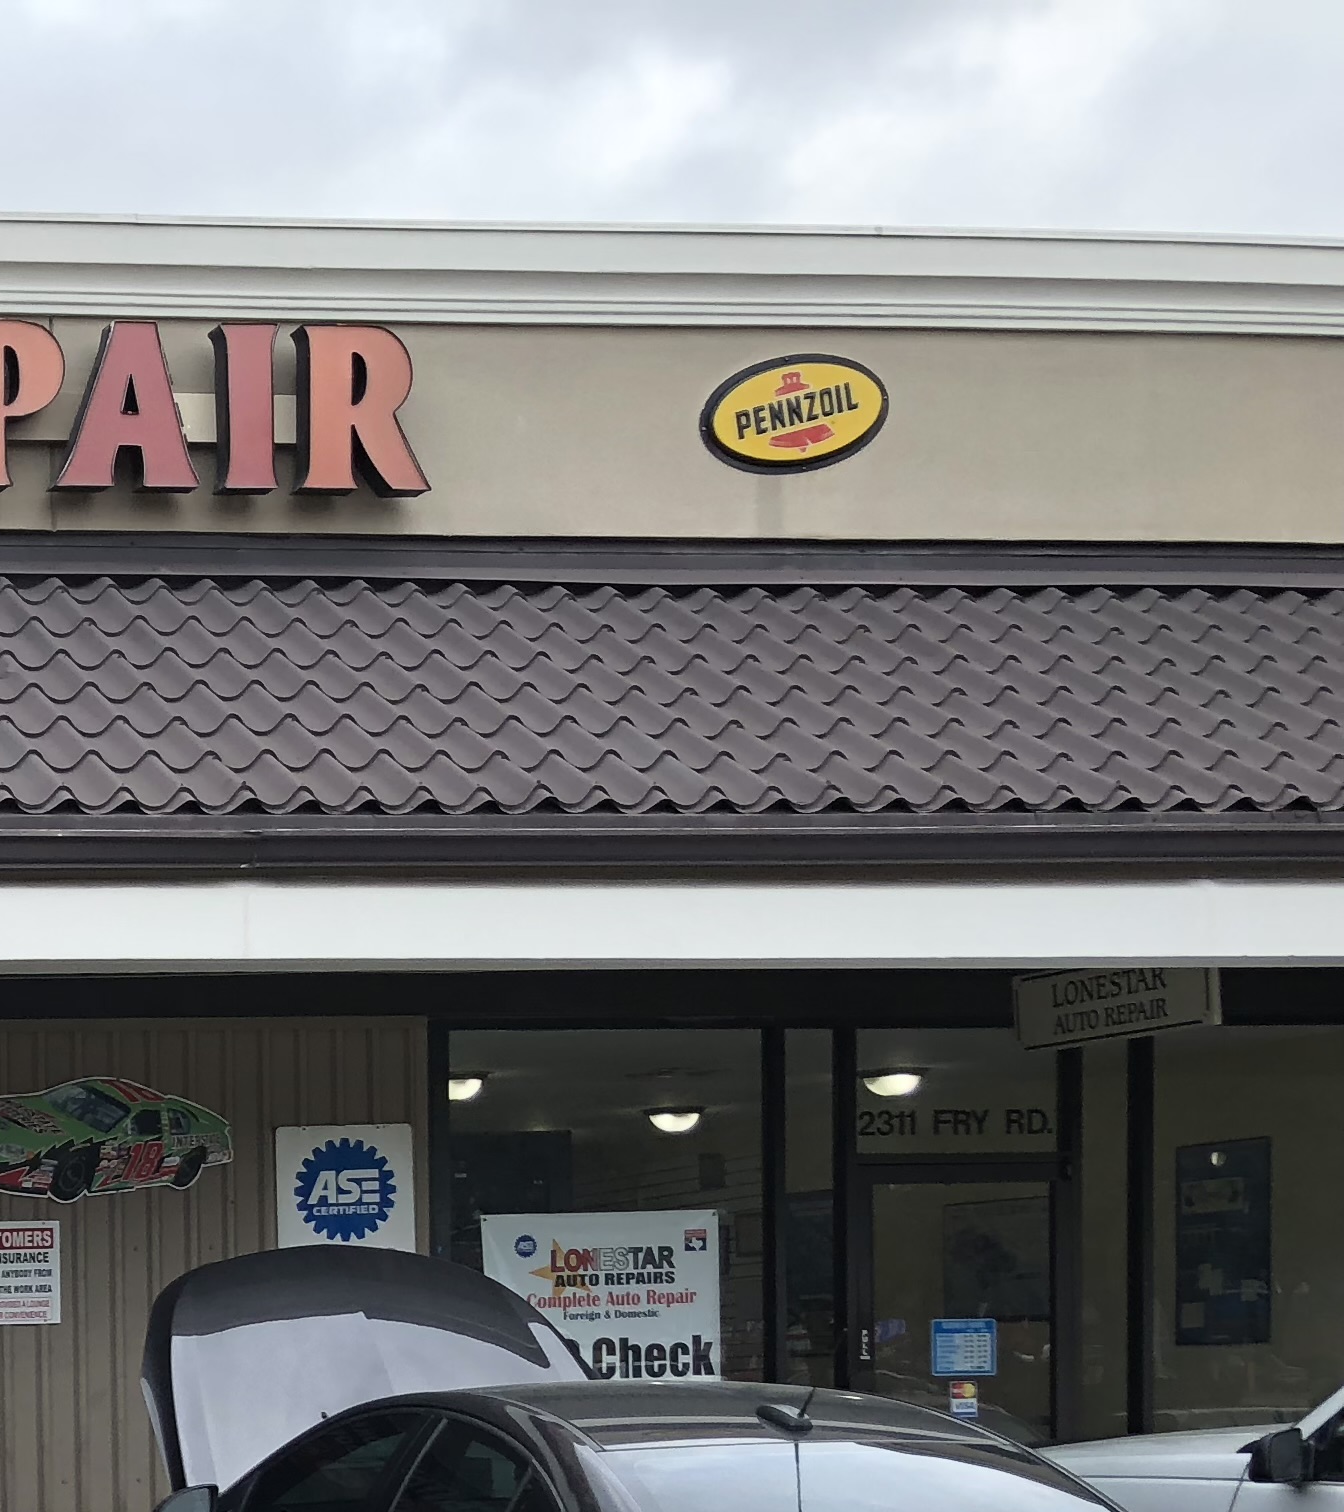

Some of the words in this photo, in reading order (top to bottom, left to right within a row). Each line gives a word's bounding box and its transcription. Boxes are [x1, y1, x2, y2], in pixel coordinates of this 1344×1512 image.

[734, 382, 860, 440] PENNZOIL
[1051, 967, 1167, 1008] LONESTAR
[1054, 1009, 1099, 1035] AUTO
[1104, 998, 1169, 1028] REPAIR
[858, 1109, 917, 1136] 2311
[933, 1109, 990, 1136] FRY
[1005, 1108, 1053, 1135] RD.
[121, 1140, 165, 1182] 18
[307, 1168, 381, 1205] ASE
[312, 1204, 379, 1216] CERTIFIED
[550, 1245, 676, 1273] LONESTAR
[554, 1273, 600, 1288] AUTO
[604, 1270, 676, 1287] REPAIRS
[526, 1291, 601, 1311] Complete
[605, 1290, 641, 1306] Auto
[646, 1287, 697, 1308] Repair
[563, 1309, 601, 1322] Foreign
[603, 1309, 611, 1319] &
[614, 1307, 660, 1319] Domestic
[592, 1334, 716, 1380] Check
